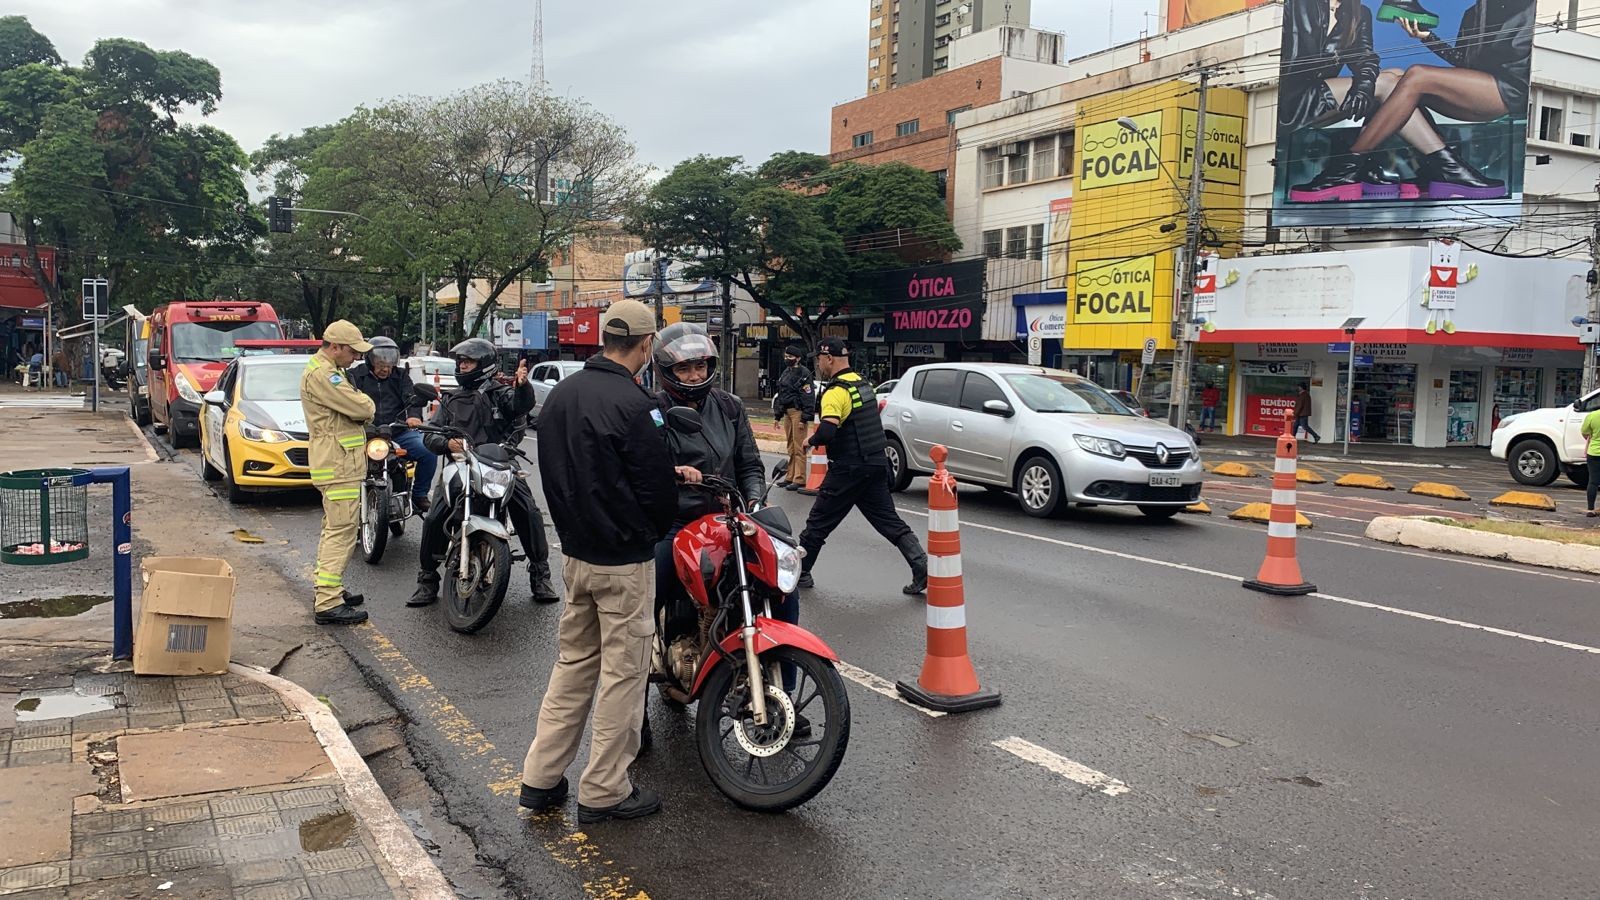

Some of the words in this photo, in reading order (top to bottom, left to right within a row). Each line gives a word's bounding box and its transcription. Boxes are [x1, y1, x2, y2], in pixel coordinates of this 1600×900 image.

[1120, 126, 1158, 145] ÓTICA
[1082, 148, 1157, 181] FOCAL
[908, 272, 955, 298] ÓTICA
[1113, 268, 1151, 284] ÓTICA
[1076, 291, 1151, 315] FOCAL
[892, 308, 972, 330] TAMIOZZO
[1260, 398, 1296, 408] REMÉDIO
[1260, 407, 1271, 415] DE
